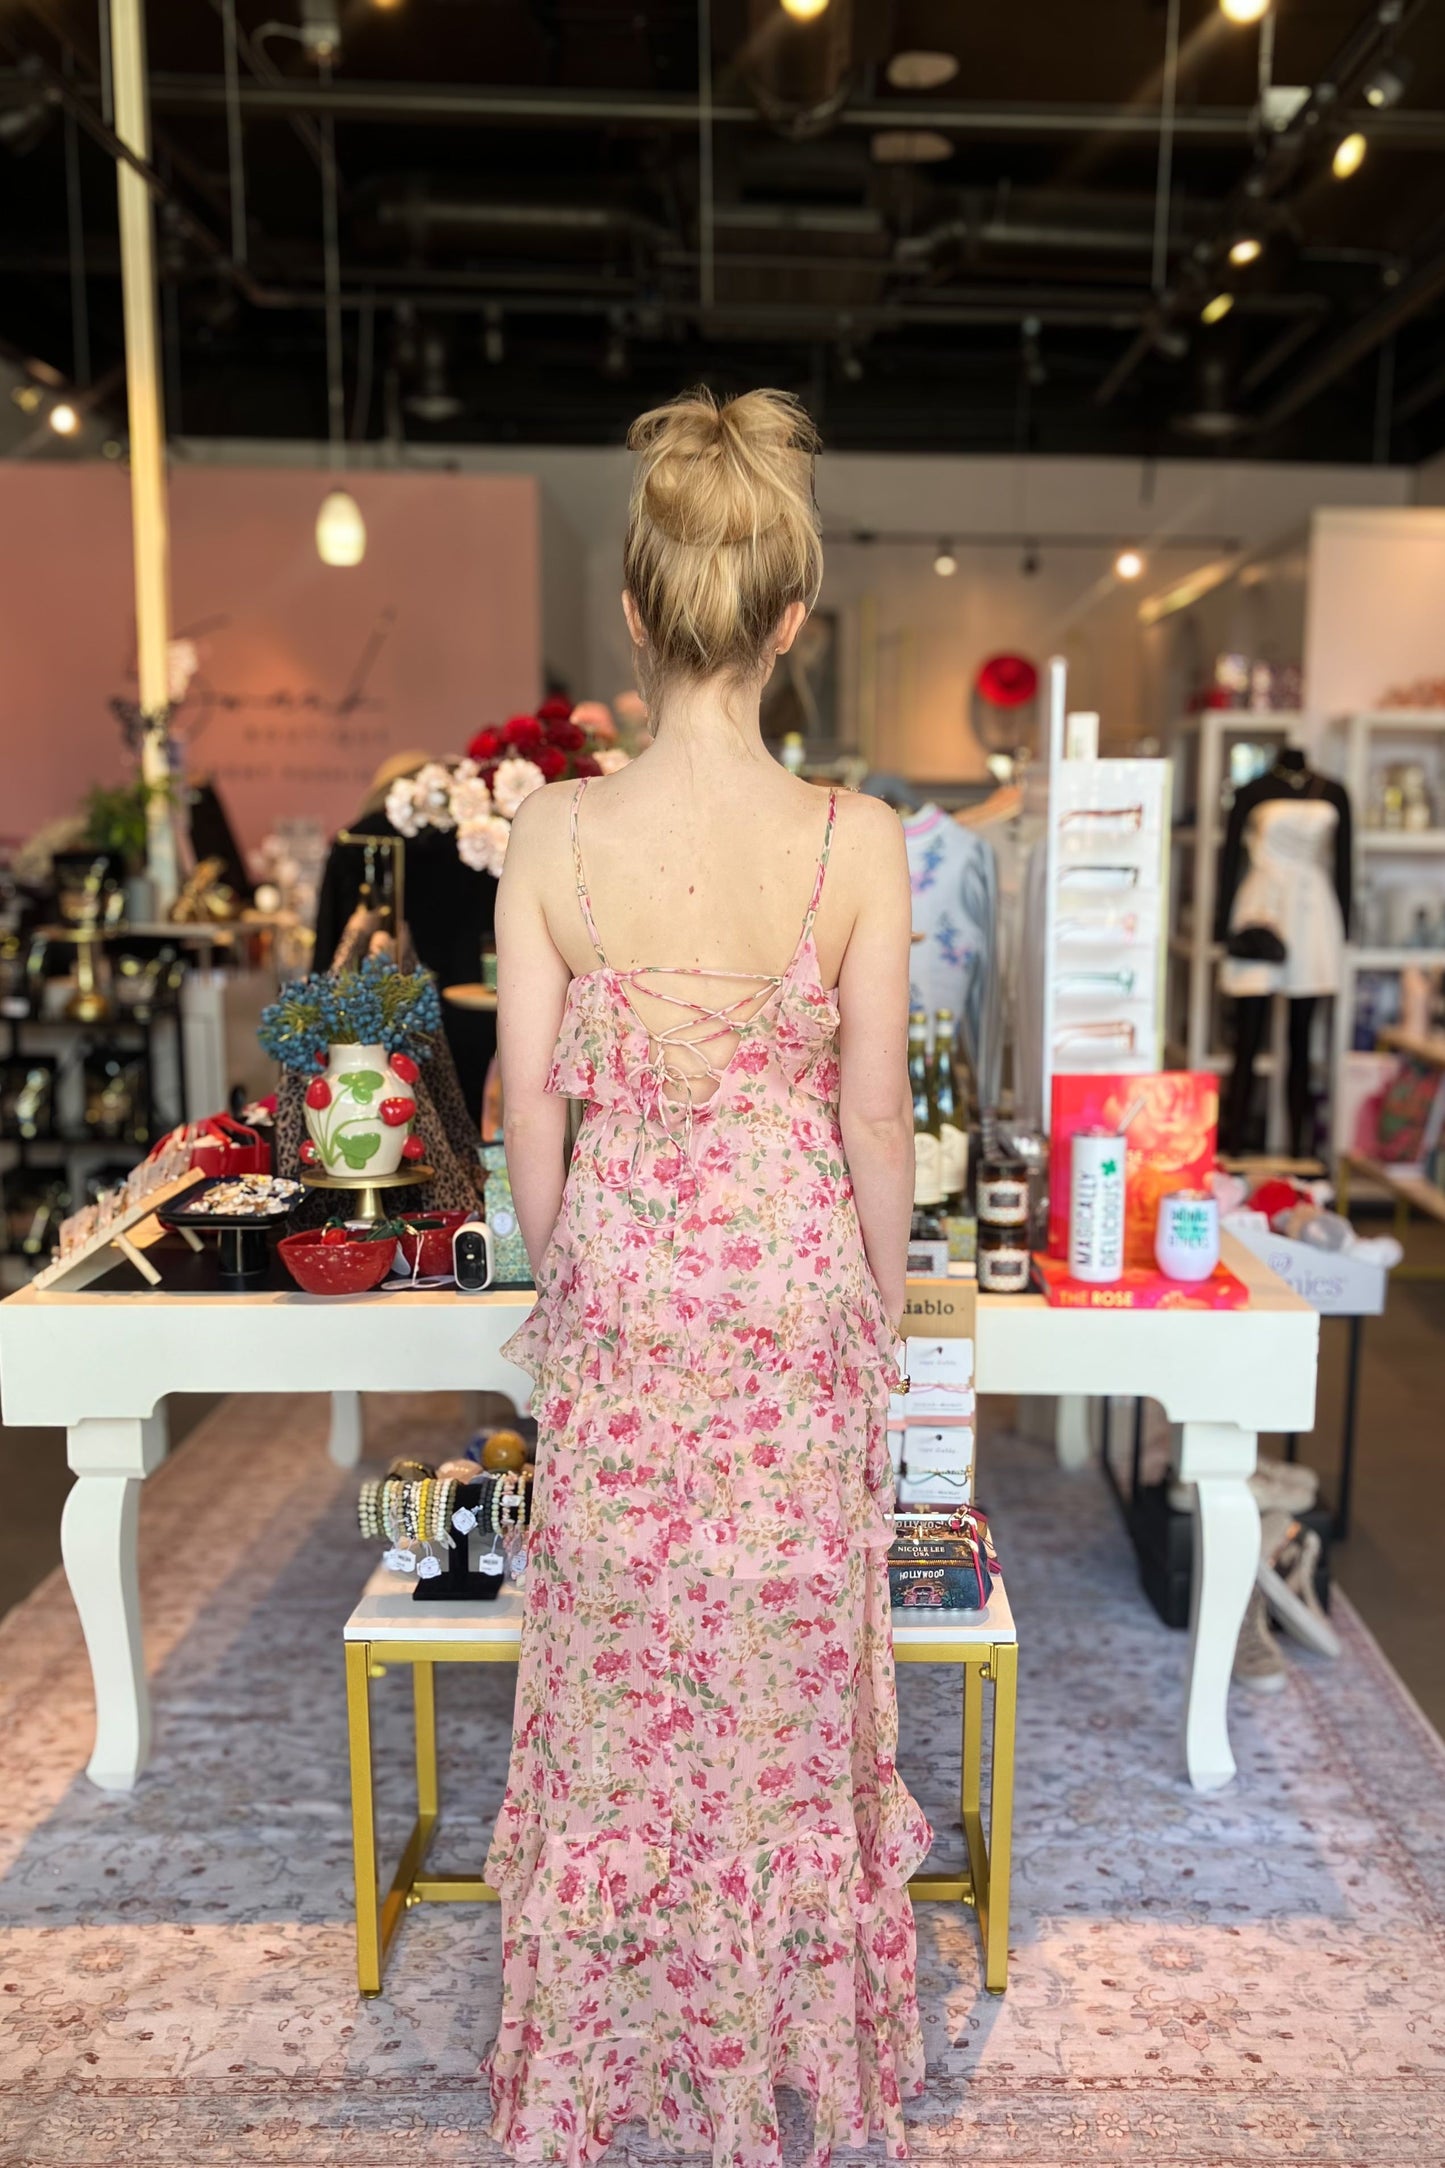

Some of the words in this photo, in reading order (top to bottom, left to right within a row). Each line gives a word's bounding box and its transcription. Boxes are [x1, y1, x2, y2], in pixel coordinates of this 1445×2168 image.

[1101, 1180, 1120, 1267] DELICIOUS
[1059, 1290, 1088, 1306] THE
[1092, 1290, 1133, 1307] ROSE
[903, 1299, 954, 1315] iablo
[900, 1569, 944, 1580] HOLLYWOOD
